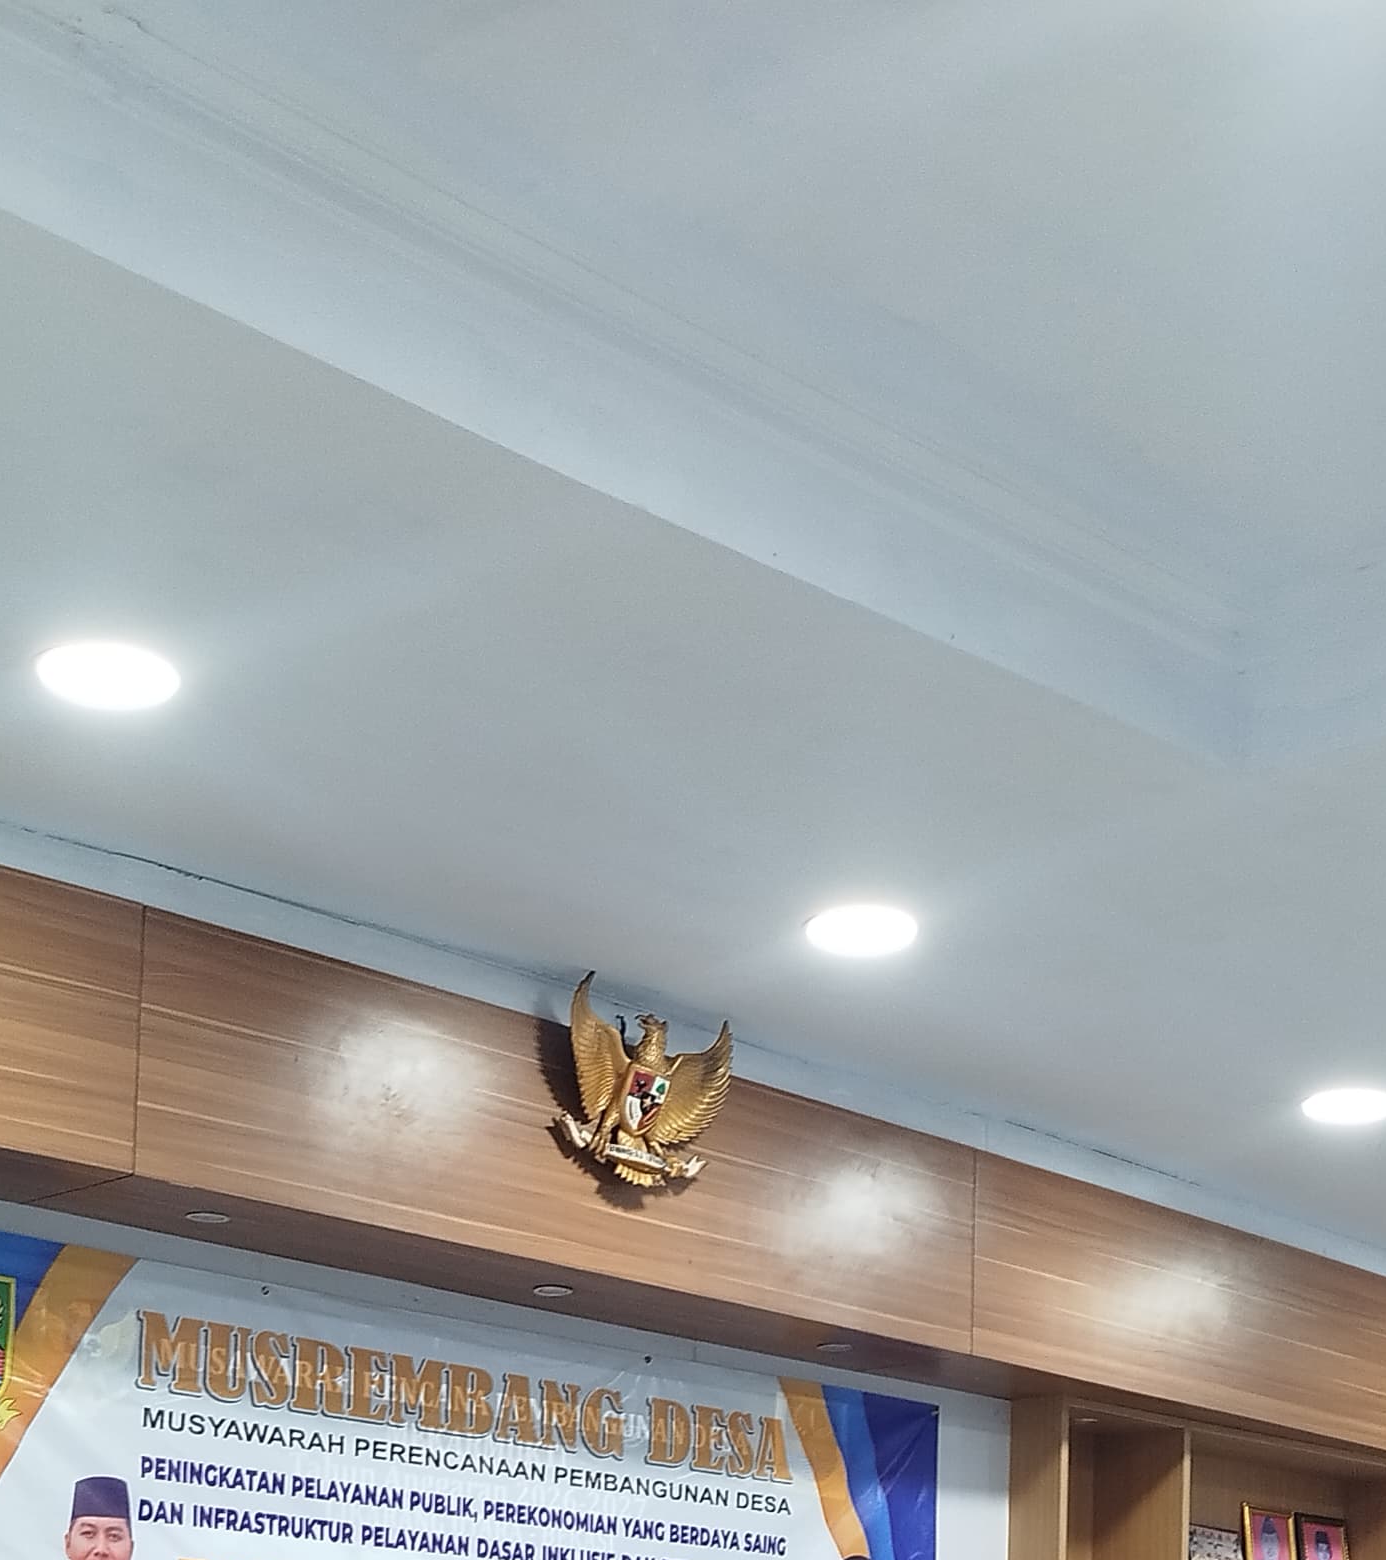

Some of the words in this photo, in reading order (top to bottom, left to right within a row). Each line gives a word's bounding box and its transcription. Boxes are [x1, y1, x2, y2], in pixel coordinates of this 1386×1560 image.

[135, 1309, 624, 1461] MUSREMBANG
[645, 1397, 794, 1484] DESA
[141, 1456, 285, 1495] PENINGKATAN
[292, 1475, 404, 1509] PELAYANAN
[410, 1490, 478, 1523] PUBLIK,
[483, 1500, 617, 1535] PEREKONOMIAN
[622, 1518, 664, 1541] YANG
[669, 1523, 739, 1550] BERDAYA
[744, 1533, 786, 1556] SAING
[143, 1407, 344, 1454] MUSYAWARAH
[355, 1439, 545, 1482] PERENCANAAN
[554, 1467, 728, 1507] PEMBANGUNAN
[736, 1492, 791, 1515] DESA
[138, 1499, 184, 1525] DAN
[192, 1504, 353, 1544] INFRASTRUKTUR
[361, 1524, 469, 1557] PELAYANAN
